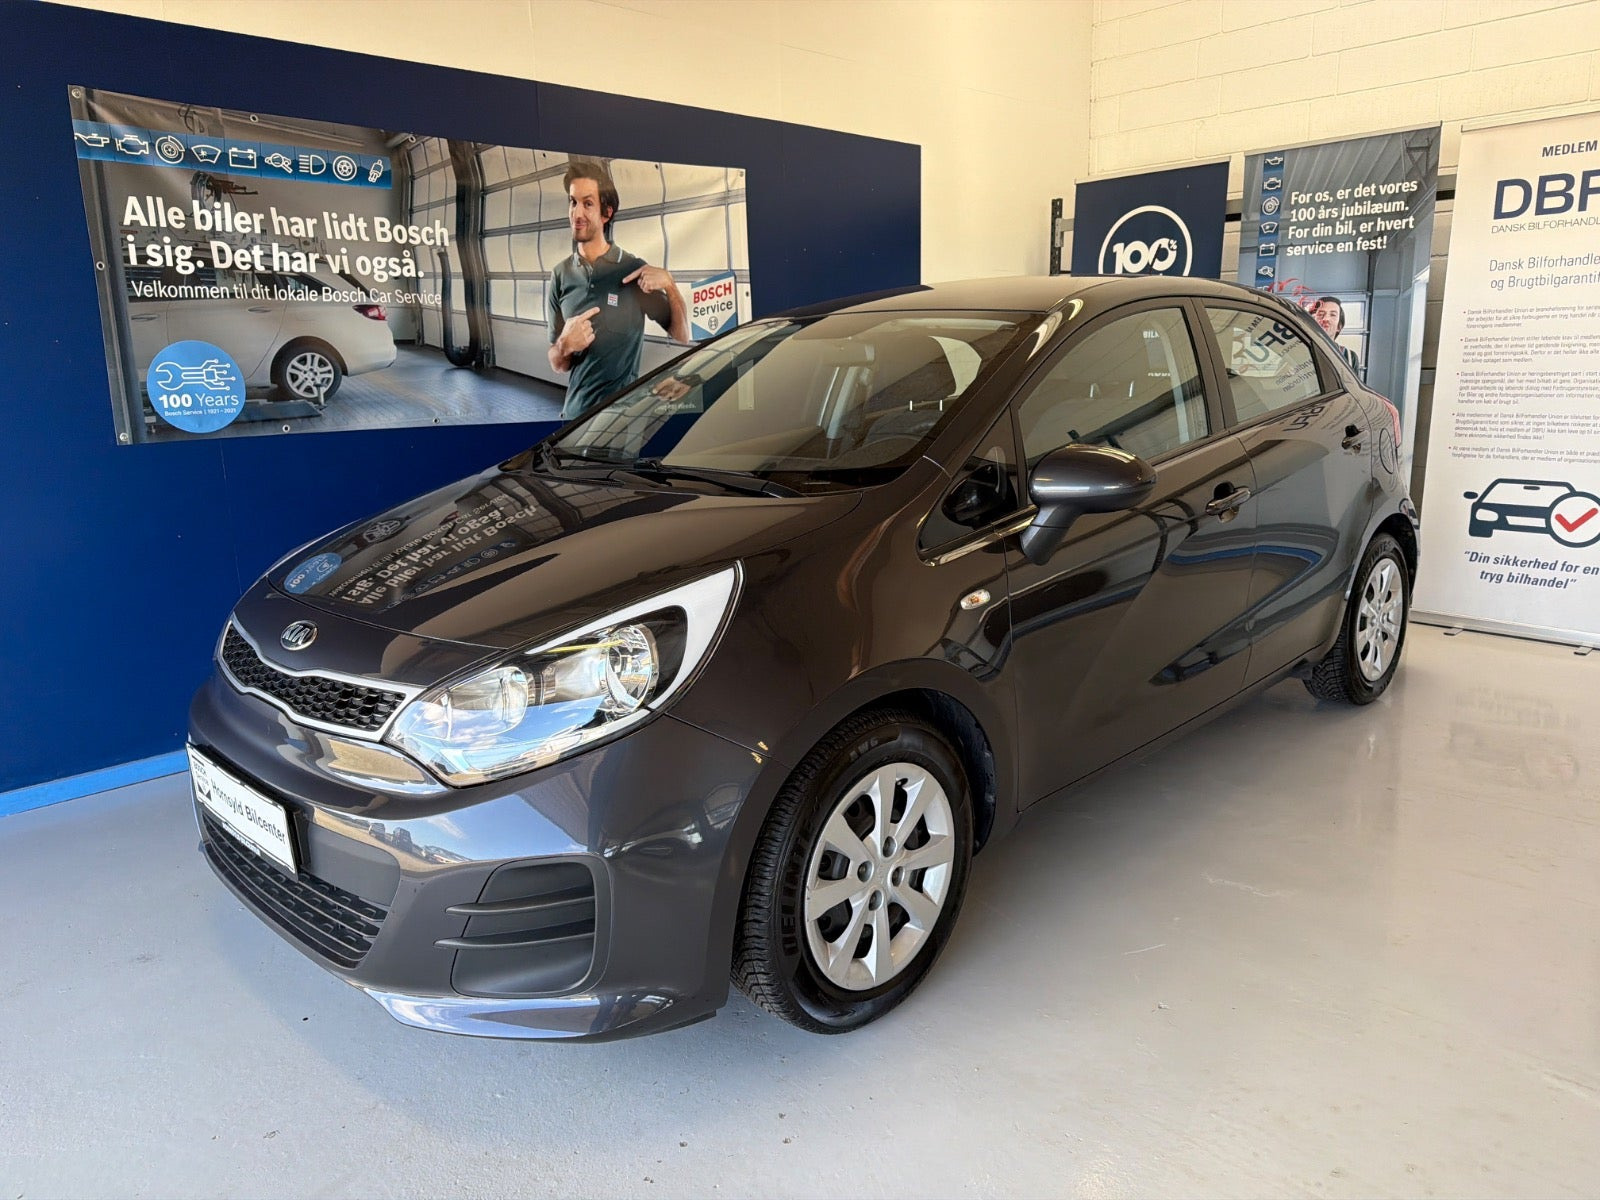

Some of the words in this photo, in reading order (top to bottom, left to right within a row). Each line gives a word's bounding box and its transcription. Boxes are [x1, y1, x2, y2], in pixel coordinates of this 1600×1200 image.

[1542, 140, 1598, 158] MEDLEM
[1290, 191, 1312, 206] For
[1315, 191, 1333, 203] os,
[1336, 188, 1351, 200] er
[1354, 183, 1376, 197] det
[1379, 180, 1418, 194] vores
[123, 195, 187, 229] Alle
[192, 199, 264, 234] biler
[270, 206, 317, 239] har
[322, 211, 370, 242] lidt
[374, 216, 450, 247] Bosch
[1290, 208, 1316, 222] 100
[1318, 205, 1338, 219] års
[1340, 200, 1410, 220] jubilæum.
[1288, 225, 1310, 240] For
[1312, 223, 1333, 237] din
[1335, 220, 1357, 237] bil,
[1359, 221, 1374, 233] er
[1376, 215, 1415, 232] hvert
[1491, 222, 1527, 234] DANSK
[1528, 217, 1600, 231] BILFORHANDL
[1286, 242, 1333, 257] service
[1336, 241, 1353, 252] en
[1356, 236, 1388, 251] fest!
[126, 234, 138, 266] i
[145, 236, 205, 275] sig.
[209, 240, 265, 271] Det
[272, 242, 319, 273] har
[325, 247, 351, 275] vi
[356, 250, 425, 283] også.
[1489, 258, 1524, 272] Dansk
[1528, 252, 1600, 269] Bilforhandle
[131, 280, 229, 299] Velkommen
[232, 281, 248, 300] til
[251, 281, 271, 300] dit
[273, 284, 318, 302] lokale
[322, 286, 366, 303] Bosch
[369, 288, 392, 303] Car
[395, 289, 442, 305] Service
[692, 281, 733, 304] BOSCH
[1491, 278, 1504, 292] og
[692, 298, 733, 318] Service
[158, 393, 193, 409] 100
[195, 392, 239, 407] Years
[1493, 555, 1559, 571] sikkerhed
[1560, 561, 1580, 574] for
[1583, 565, 1600, 576] en
[1479, 571, 1504, 584] tryg
[282, 623, 310, 646] KIA
[211, 778, 245, 817] Hornsyld
[245, 804, 286, 846] Bilcenter
